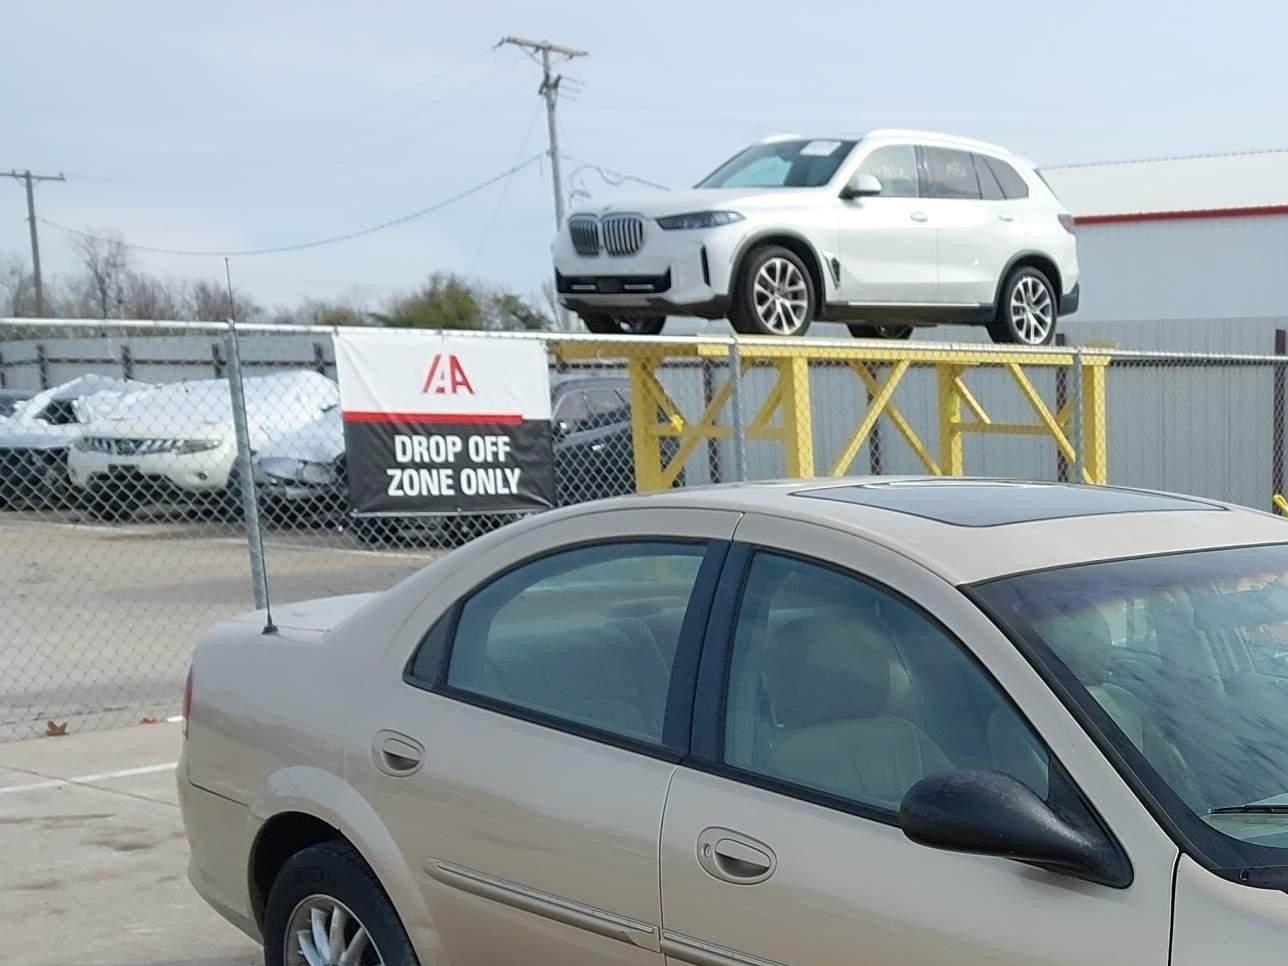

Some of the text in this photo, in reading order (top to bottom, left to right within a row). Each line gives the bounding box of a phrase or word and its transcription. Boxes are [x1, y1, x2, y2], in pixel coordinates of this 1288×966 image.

[394, 434, 511, 463] DROP OFF
[386, 467, 521, 497] ZONE ONLY
